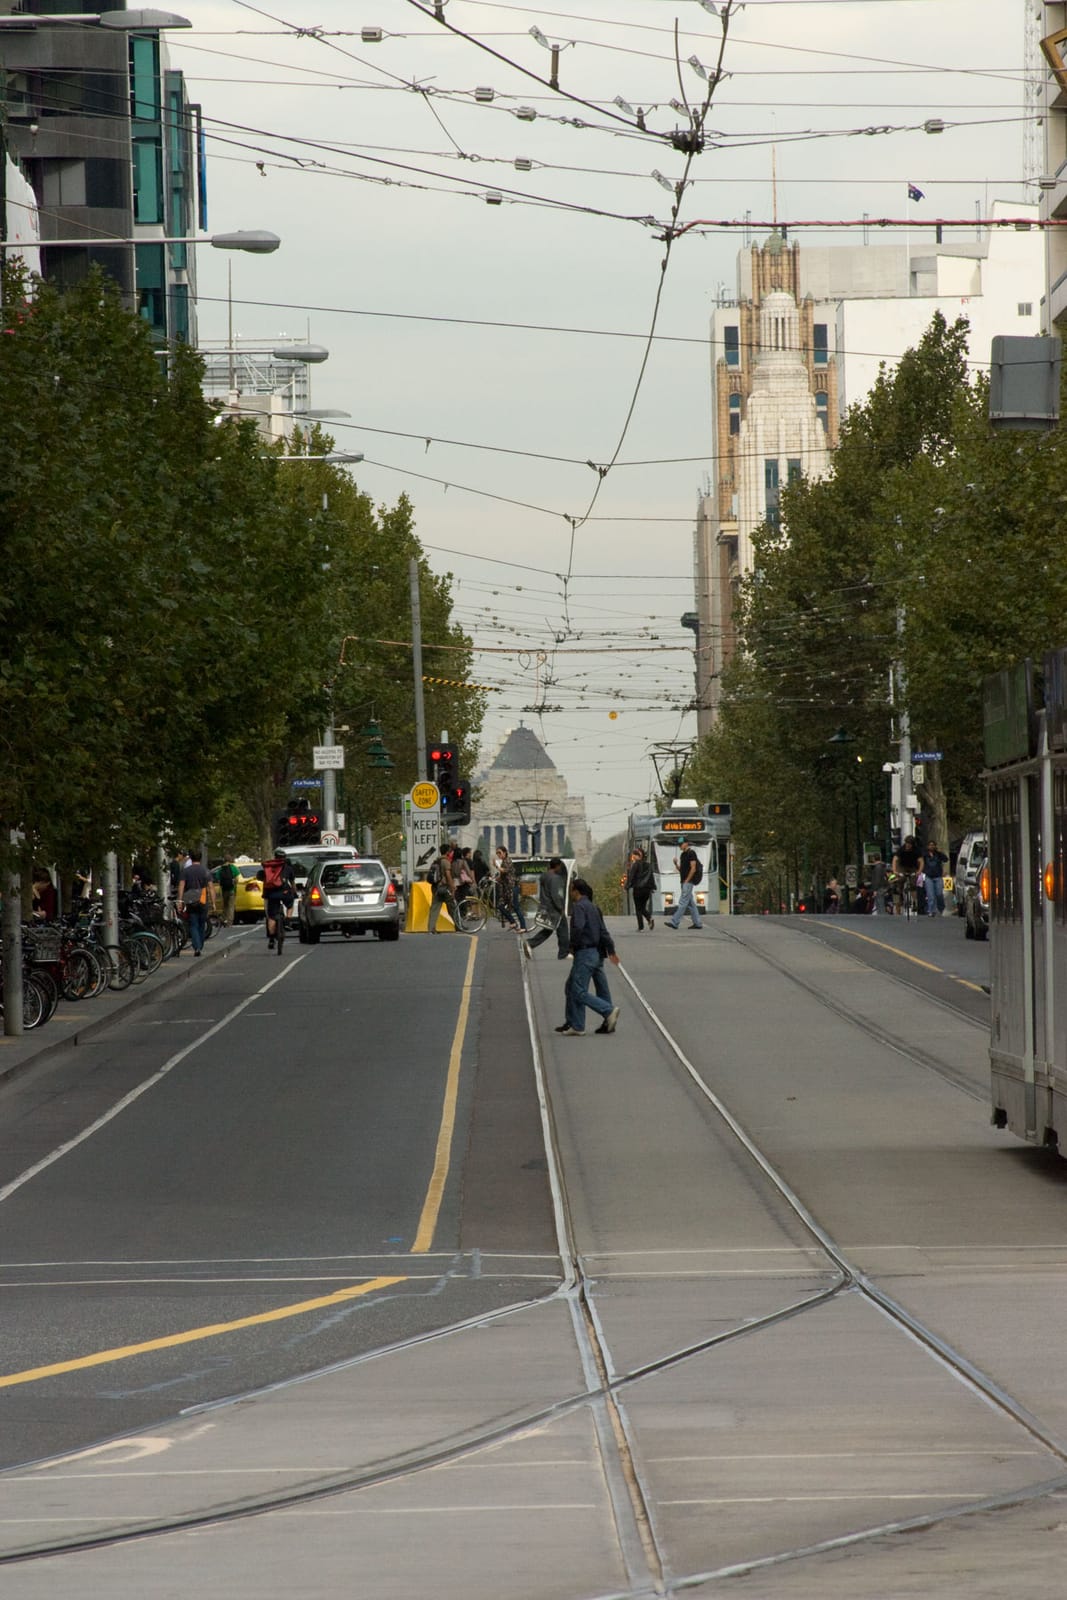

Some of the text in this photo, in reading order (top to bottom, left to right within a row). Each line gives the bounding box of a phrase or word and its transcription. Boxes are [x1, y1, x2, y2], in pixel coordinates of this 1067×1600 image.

[415, 788, 434, 796] SAFETY
[418, 797, 432, 805] ZONE
[413, 819, 438, 830] KEEP
[414, 834, 437, 845] LEFT
